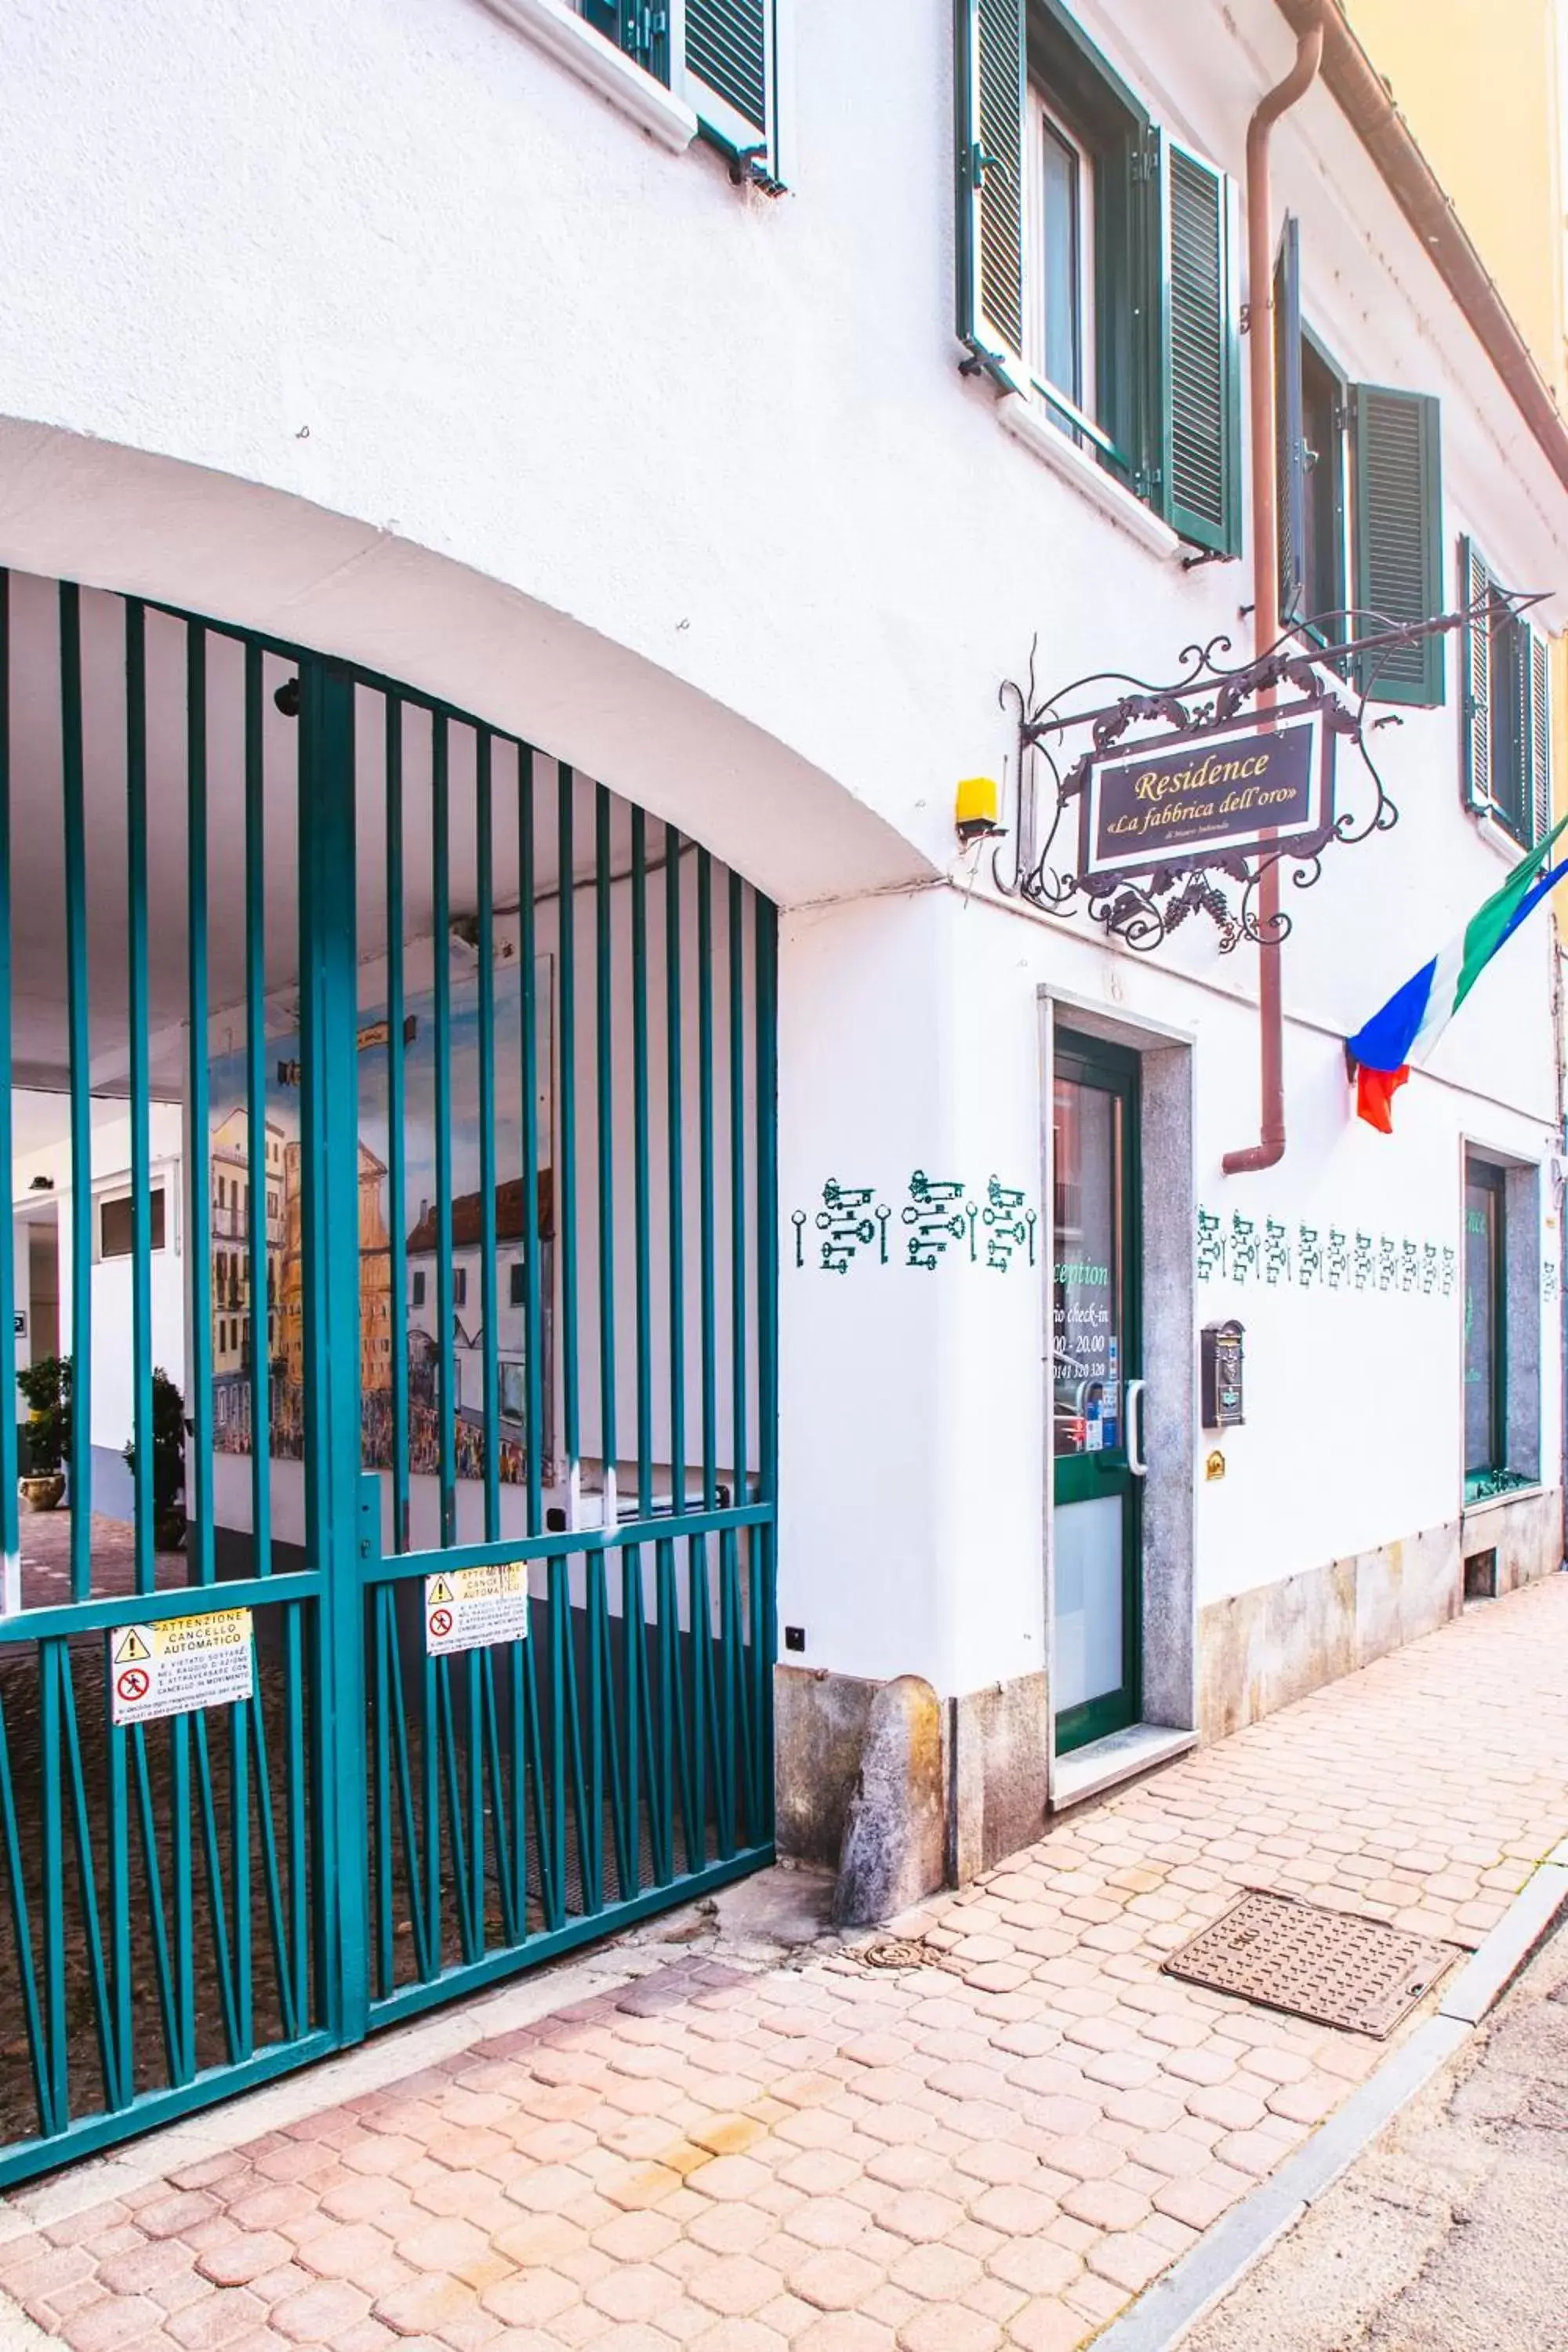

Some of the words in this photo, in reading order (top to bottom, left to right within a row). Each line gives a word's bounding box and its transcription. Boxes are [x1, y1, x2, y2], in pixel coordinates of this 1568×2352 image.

[1134, 753, 1269, 802] Residence
[1138, 800, 1214, 835] fabbrica
[1067, 1301, 1108, 1326] check-in
[1076, 1335, 1105, 1353] 20.00
[162, 1611, 243, 1632] ATTENZIONE
[164, 1633, 241, 1655] AUTOMATICO
[169, 1624, 236, 1642] CANCELLO
[231, 1664, 248, 1672] CON
[157, 1681, 194, 1696] CANCELLO
[206, 1671, 249, 1685] MOVIMENTO
